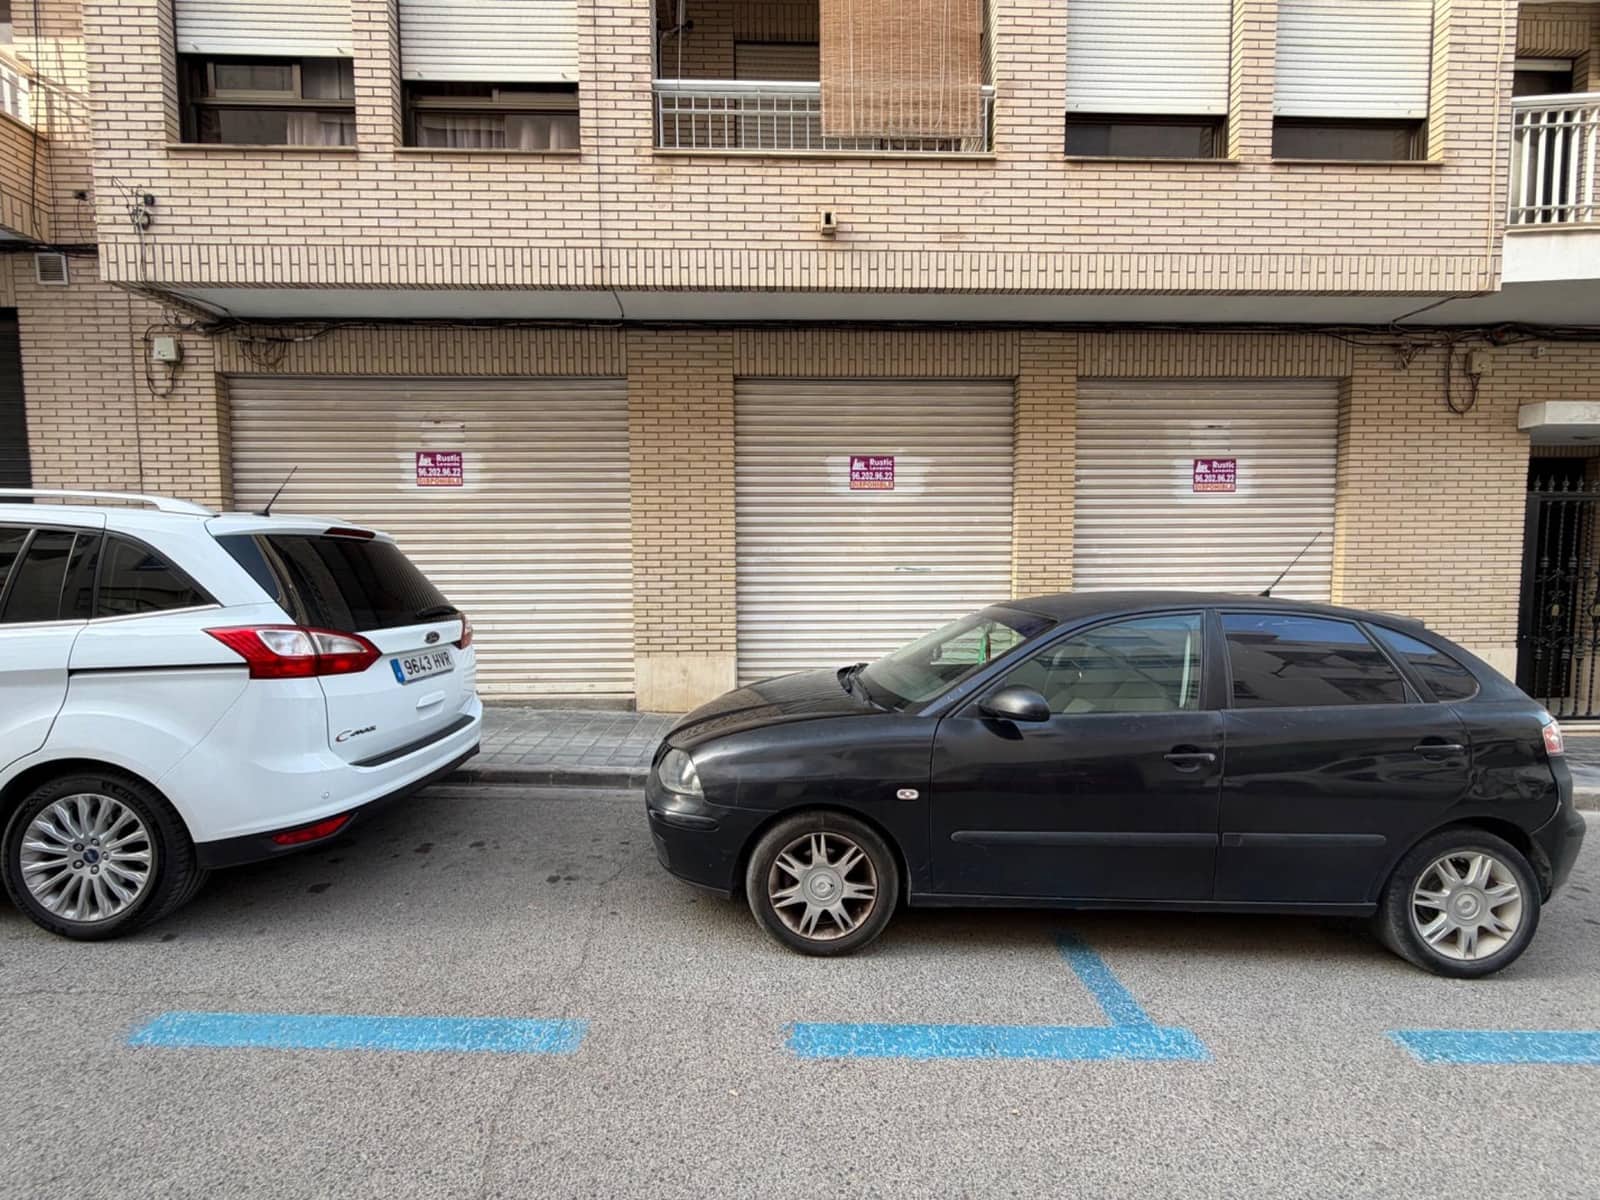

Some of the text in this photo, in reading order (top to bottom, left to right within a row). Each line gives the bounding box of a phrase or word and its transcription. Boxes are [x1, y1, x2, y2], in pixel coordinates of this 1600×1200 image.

[436, 453, 460, 461] Rustic
[869, 458, 893, 466] Rustic
[404, 651, 453, 675] 9643 HVR
